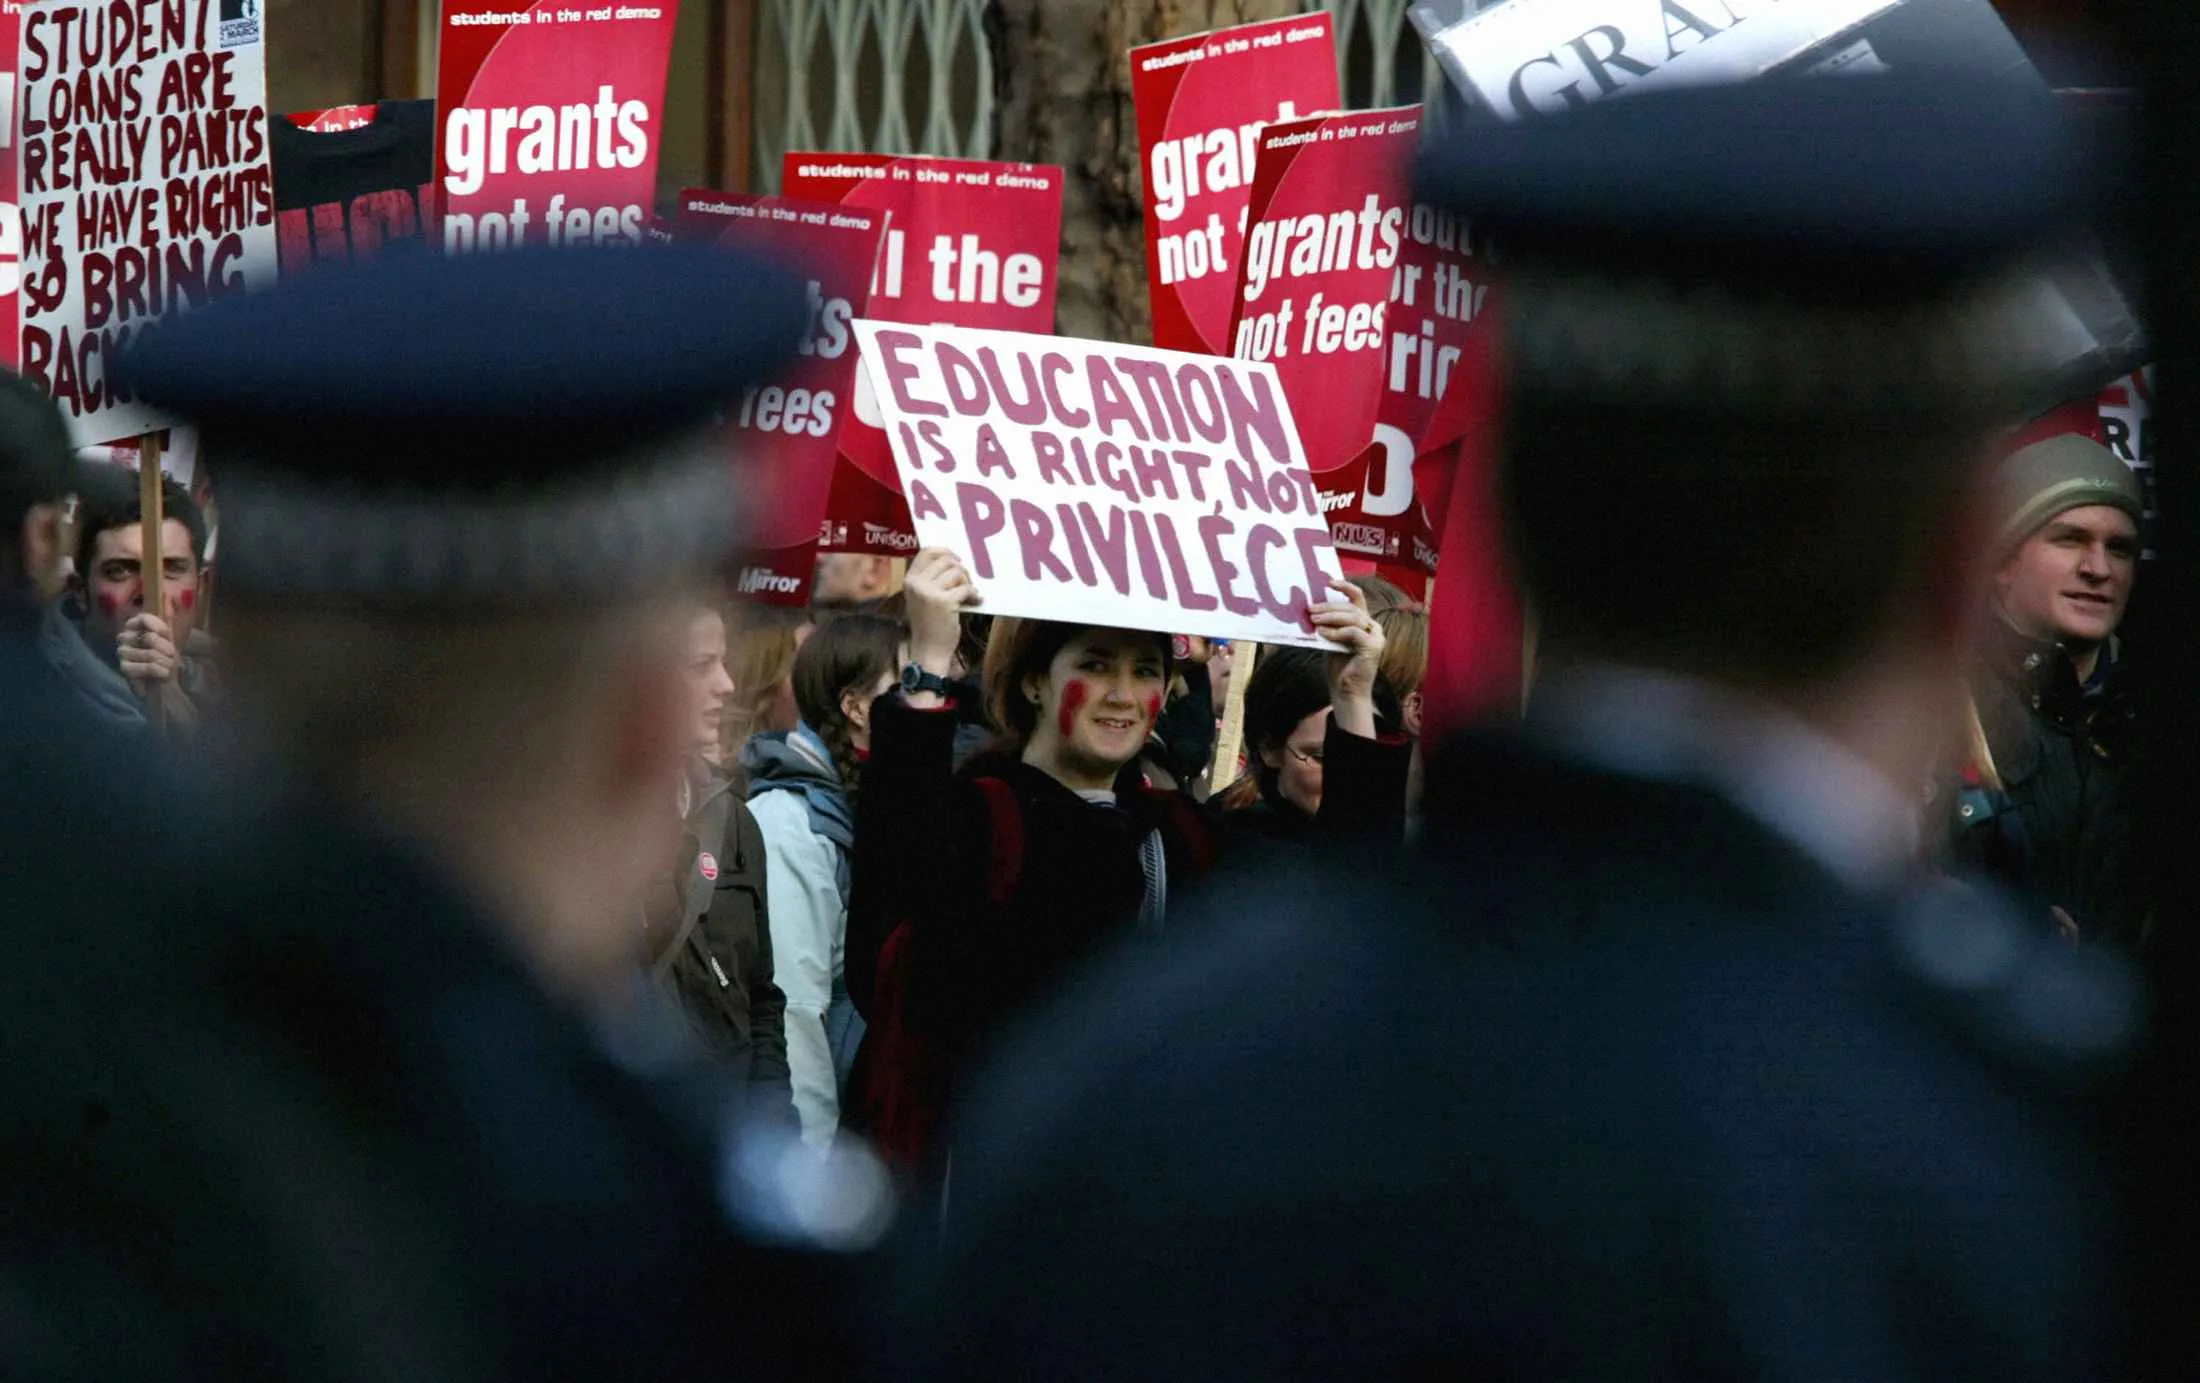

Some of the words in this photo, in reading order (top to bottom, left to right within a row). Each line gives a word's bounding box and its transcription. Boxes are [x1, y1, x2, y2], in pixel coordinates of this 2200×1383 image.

[450, 12, 530, 26] students
[537, 10, 551, 24] in
[557, 9, 580, 23] the
[586, 7, 611, 21] red
[616, 6, 660, 20] demo
[1142, 47, 1205, 72] students
[1208, 44, 1222, 58] in
[1224, 38, 1249, 55] the
[1253, 31, 1282, 49] red
[1286, 25, 1325, 44] demo
[23, 65, 143, 137] LOANS
[157, 51, 236, 116] ARE
[1508, 0, 1747, 123] GRA
[23, 116, 151, 194] REALLY
[160, 105, 265, 179] PANTS
[444, 85, 649, 196] grants
[1266, 130, 1318, 150] students
[1321, 128, 1333, 142] in
[1337, 126, 1357, 139] the
[1360, 122, 1385, 137] red
[1388, 120, 1417, 134] demo
[798, 162, 885, 179] students
[893, 166, 910, 180] in
[916, 168, 949, 184] the
[956, 172, 989, 186] red
[995, 174, 1049, 190] demo
[21, 201, 64, 260] WE
[77, 186, 159, 252] HAVE
[166, 163, 273, 240] RIGHTS
[444, 198, 530, 254] not
[546, 194, 644, 248] fees
[688, 200, 753, 217] students
[758, 208, 769, 219] in
[772, 208, 796, 222] the
[801, 212, 825, 225] red
[830, 214, 871, 230] demo
[24, 258, 66, 318] SO
[83, 232, 246, 330] BRING
[928, 234, 1042, 308] the
[1157, 213, 1227, 285] not
[1244, 194, 1402, 302] grants
[1235, 298, 1293, 361] not
[1302, 292, 1386, 355] fees
[874, 329, 1292, 465] EDUCATION
[899, 420, 956, 474] IS
[976, 423, 1016, 479] A
[1224, 458, 1319, 516] NOT
[911, 479, 947, 520] A
[1317, 491, 1356, 512] irror
[1334, 525, 1381, 547] NUS
[737, 566, 801, 594] Mirror
